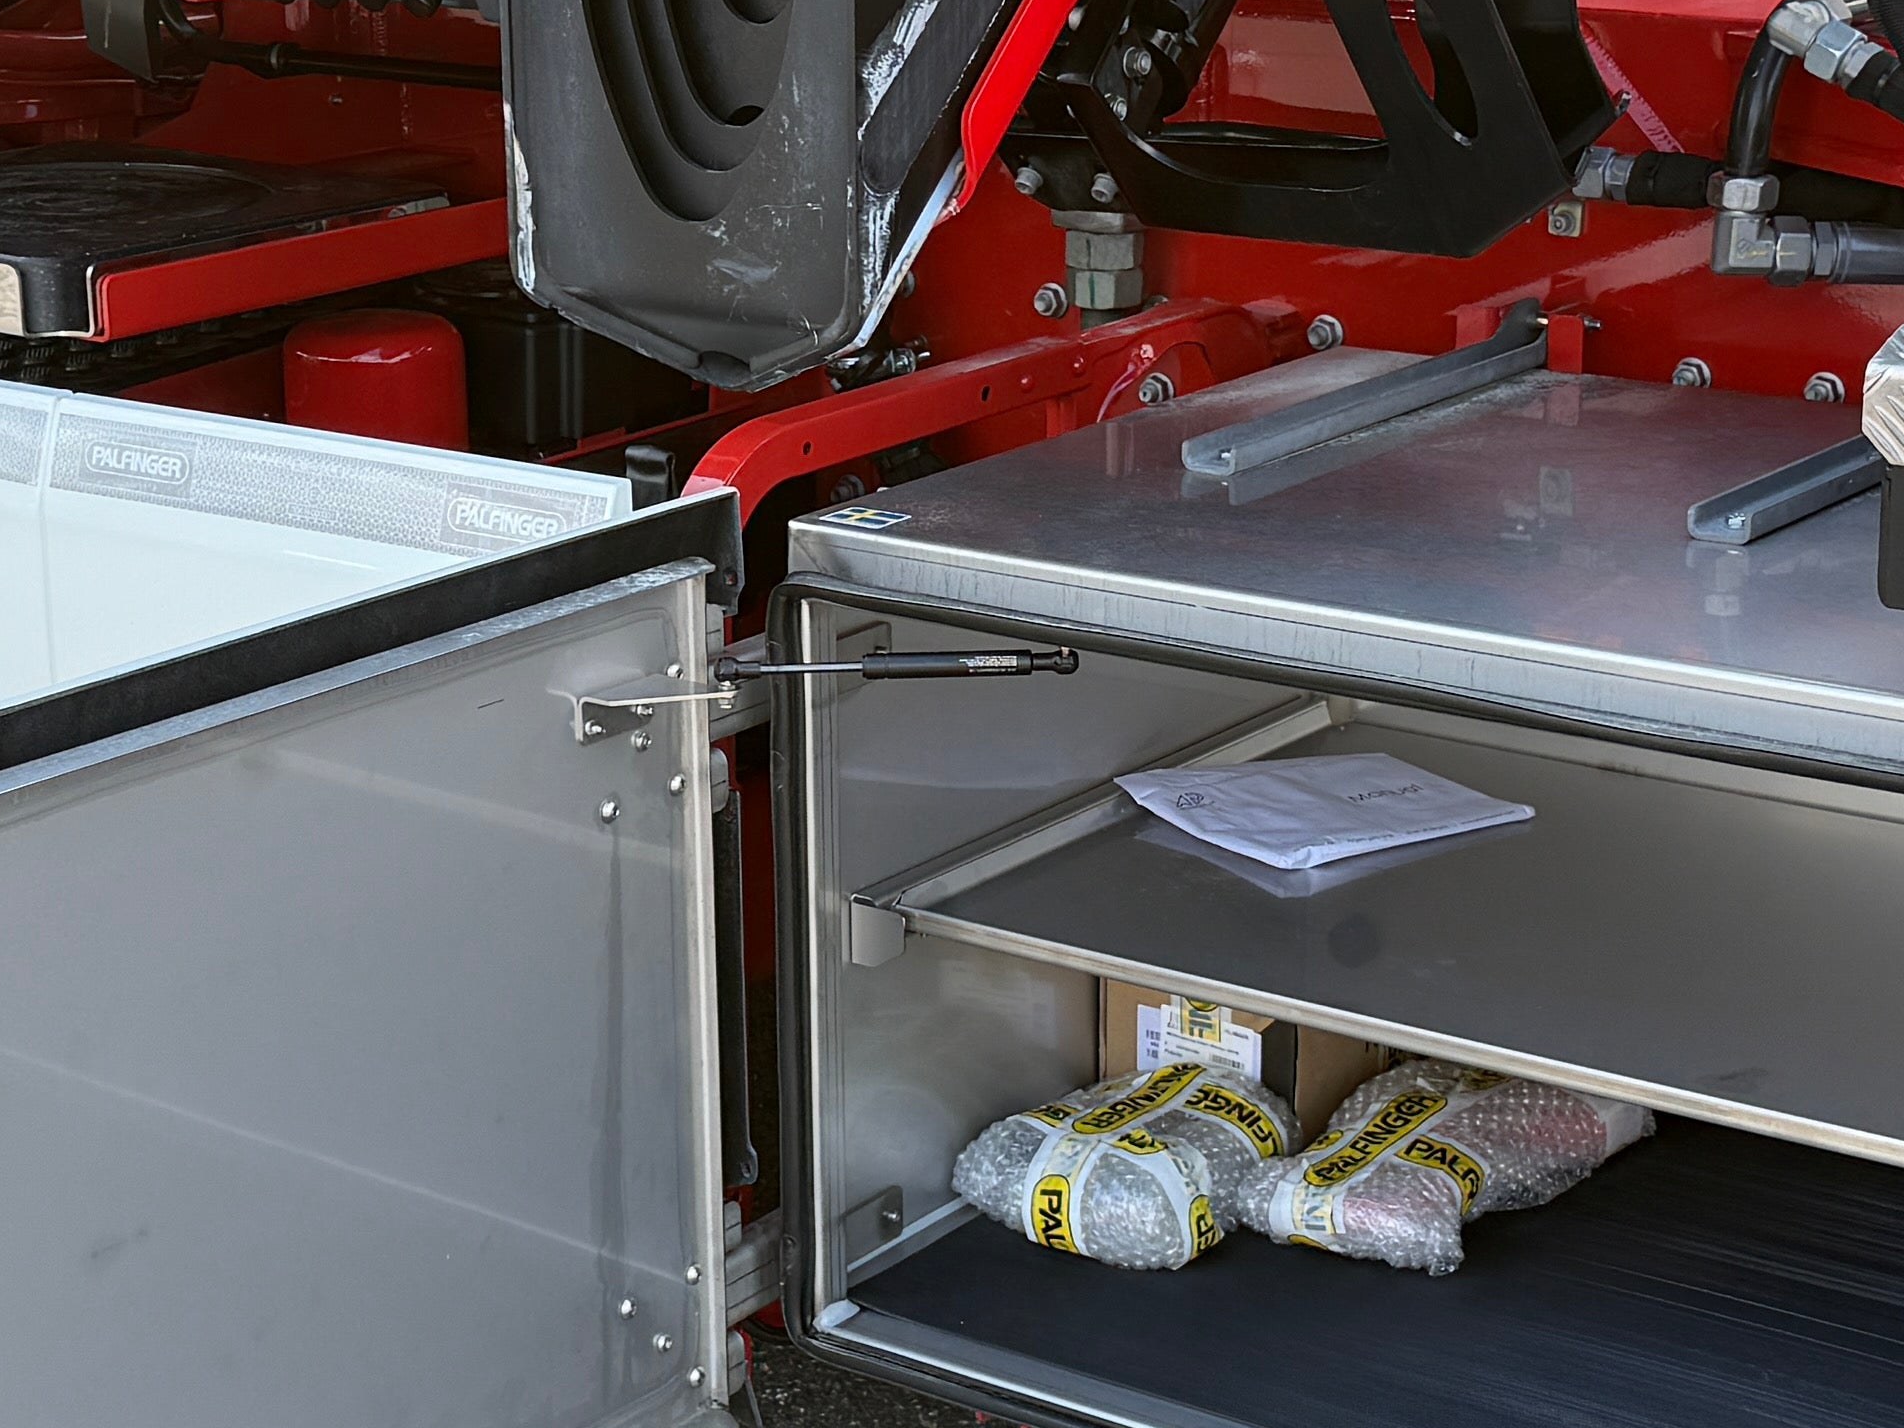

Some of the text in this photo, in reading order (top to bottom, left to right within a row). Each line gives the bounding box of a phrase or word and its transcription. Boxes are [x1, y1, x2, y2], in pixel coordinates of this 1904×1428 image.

[92, 445, 183, 480] PALFINGER
[455, 503, 560, 538] PALFINGER
[1314, 1093, 1440, 1180] PALFINGER
